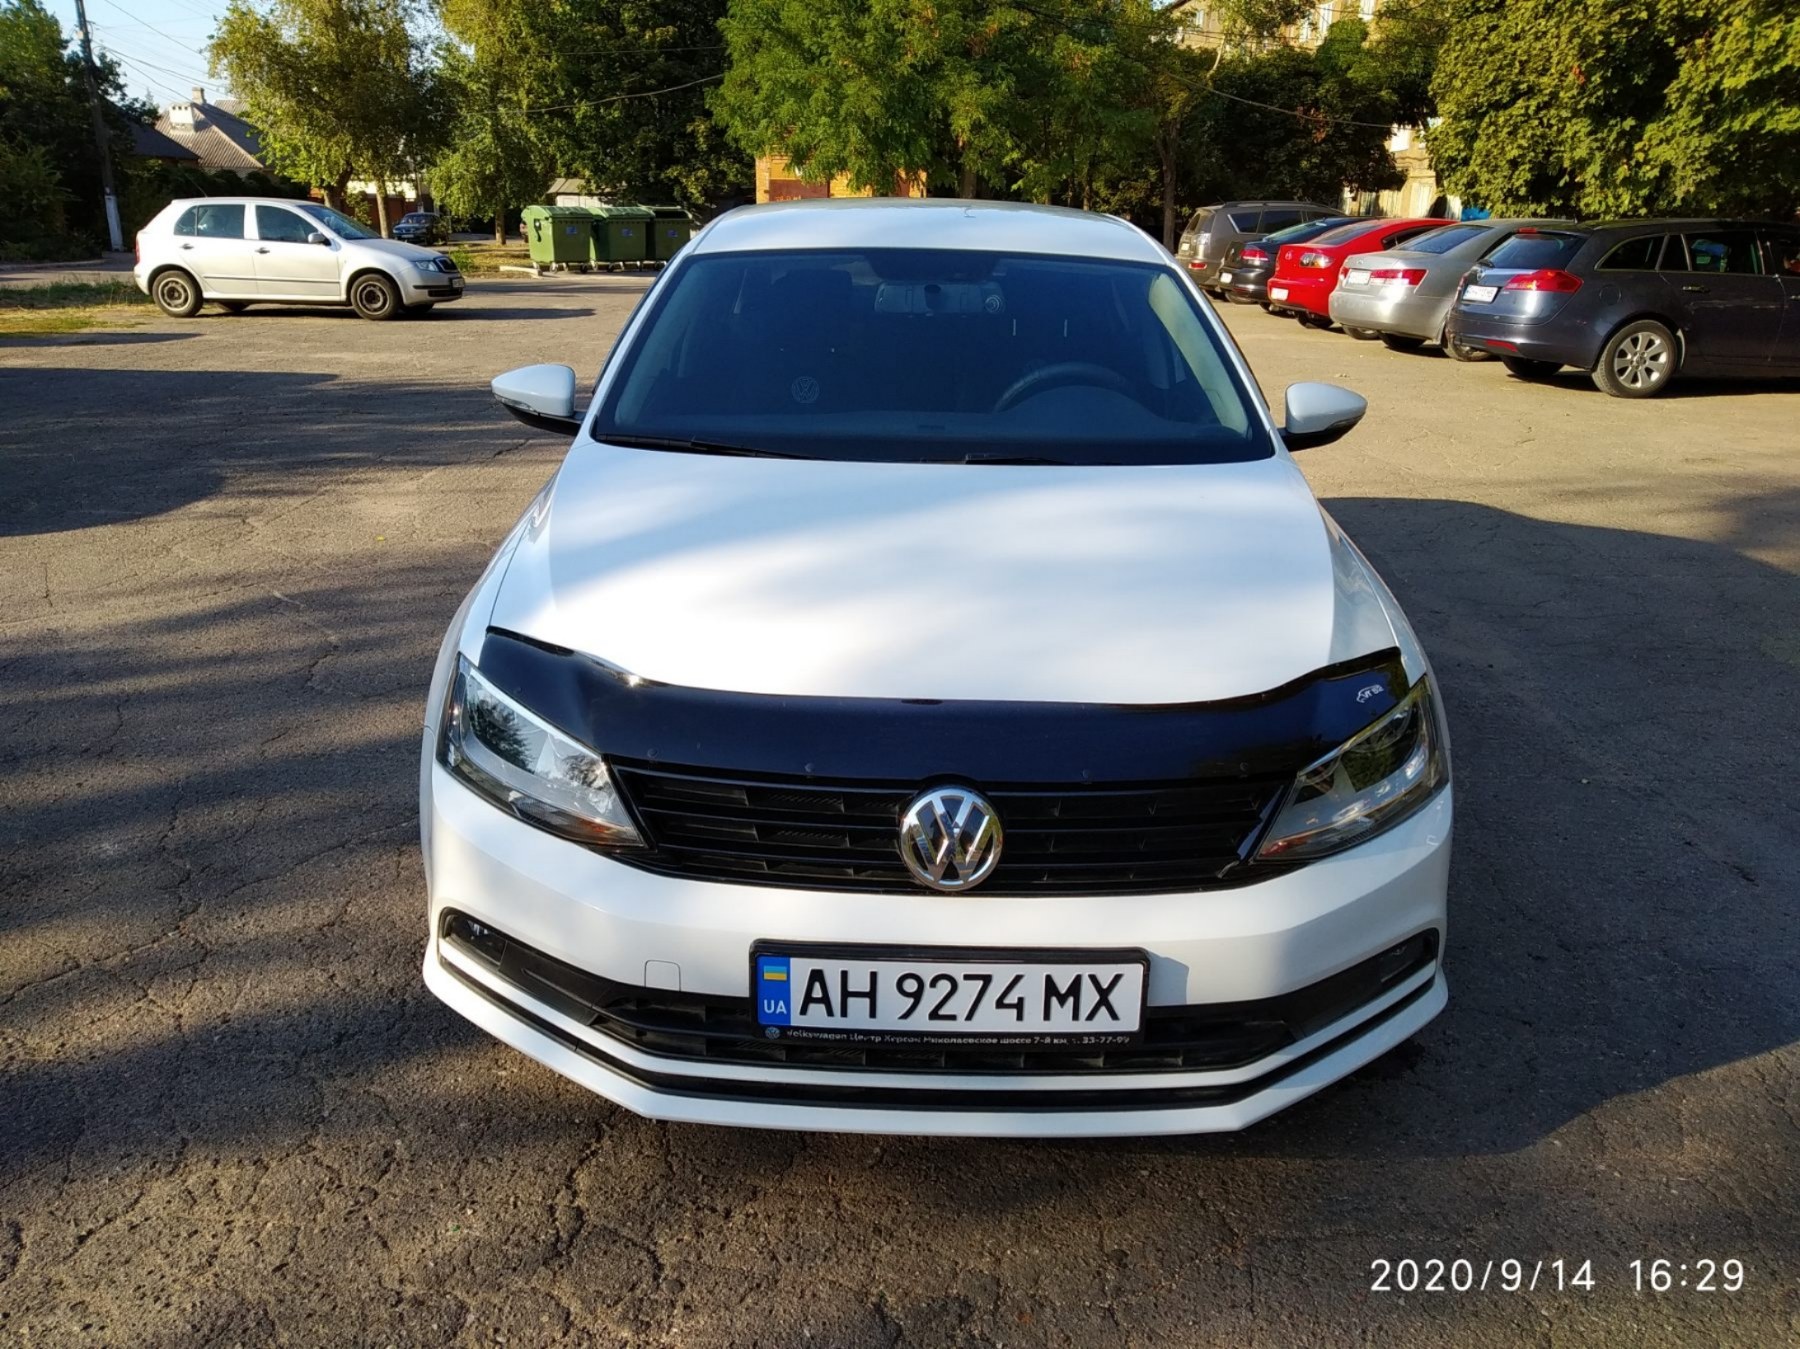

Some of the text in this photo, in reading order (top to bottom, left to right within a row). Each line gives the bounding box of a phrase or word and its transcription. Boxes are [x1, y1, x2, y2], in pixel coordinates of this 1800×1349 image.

[763, 999, 787, 1015] UA
[799, 968, 1124, 1022] AH 9274 MX
